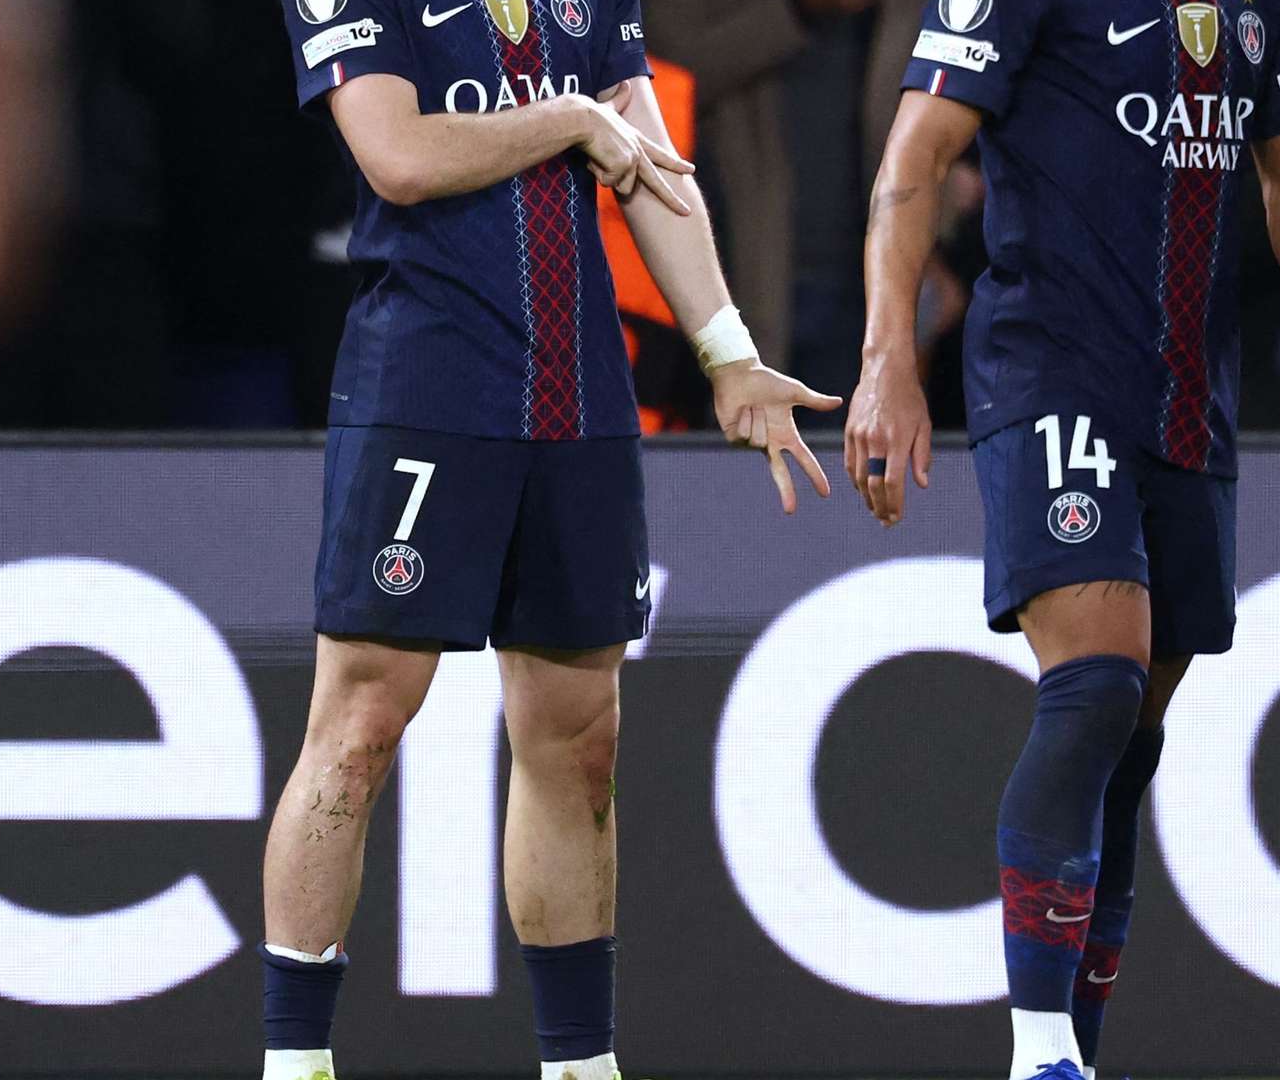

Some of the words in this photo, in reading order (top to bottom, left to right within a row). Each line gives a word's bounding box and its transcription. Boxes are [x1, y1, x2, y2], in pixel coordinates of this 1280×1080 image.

[349, 27, 371, 40] 10
[620, 23, 644, 41] BE
[1116, 93, 1254, 147] QATAR
[1035, 414, 1117, 489] 14
[393, 458, 436, 541] 7
[1055, 495, 1090, 508] PARIS
[383, 547, 417, 561] PARIS
